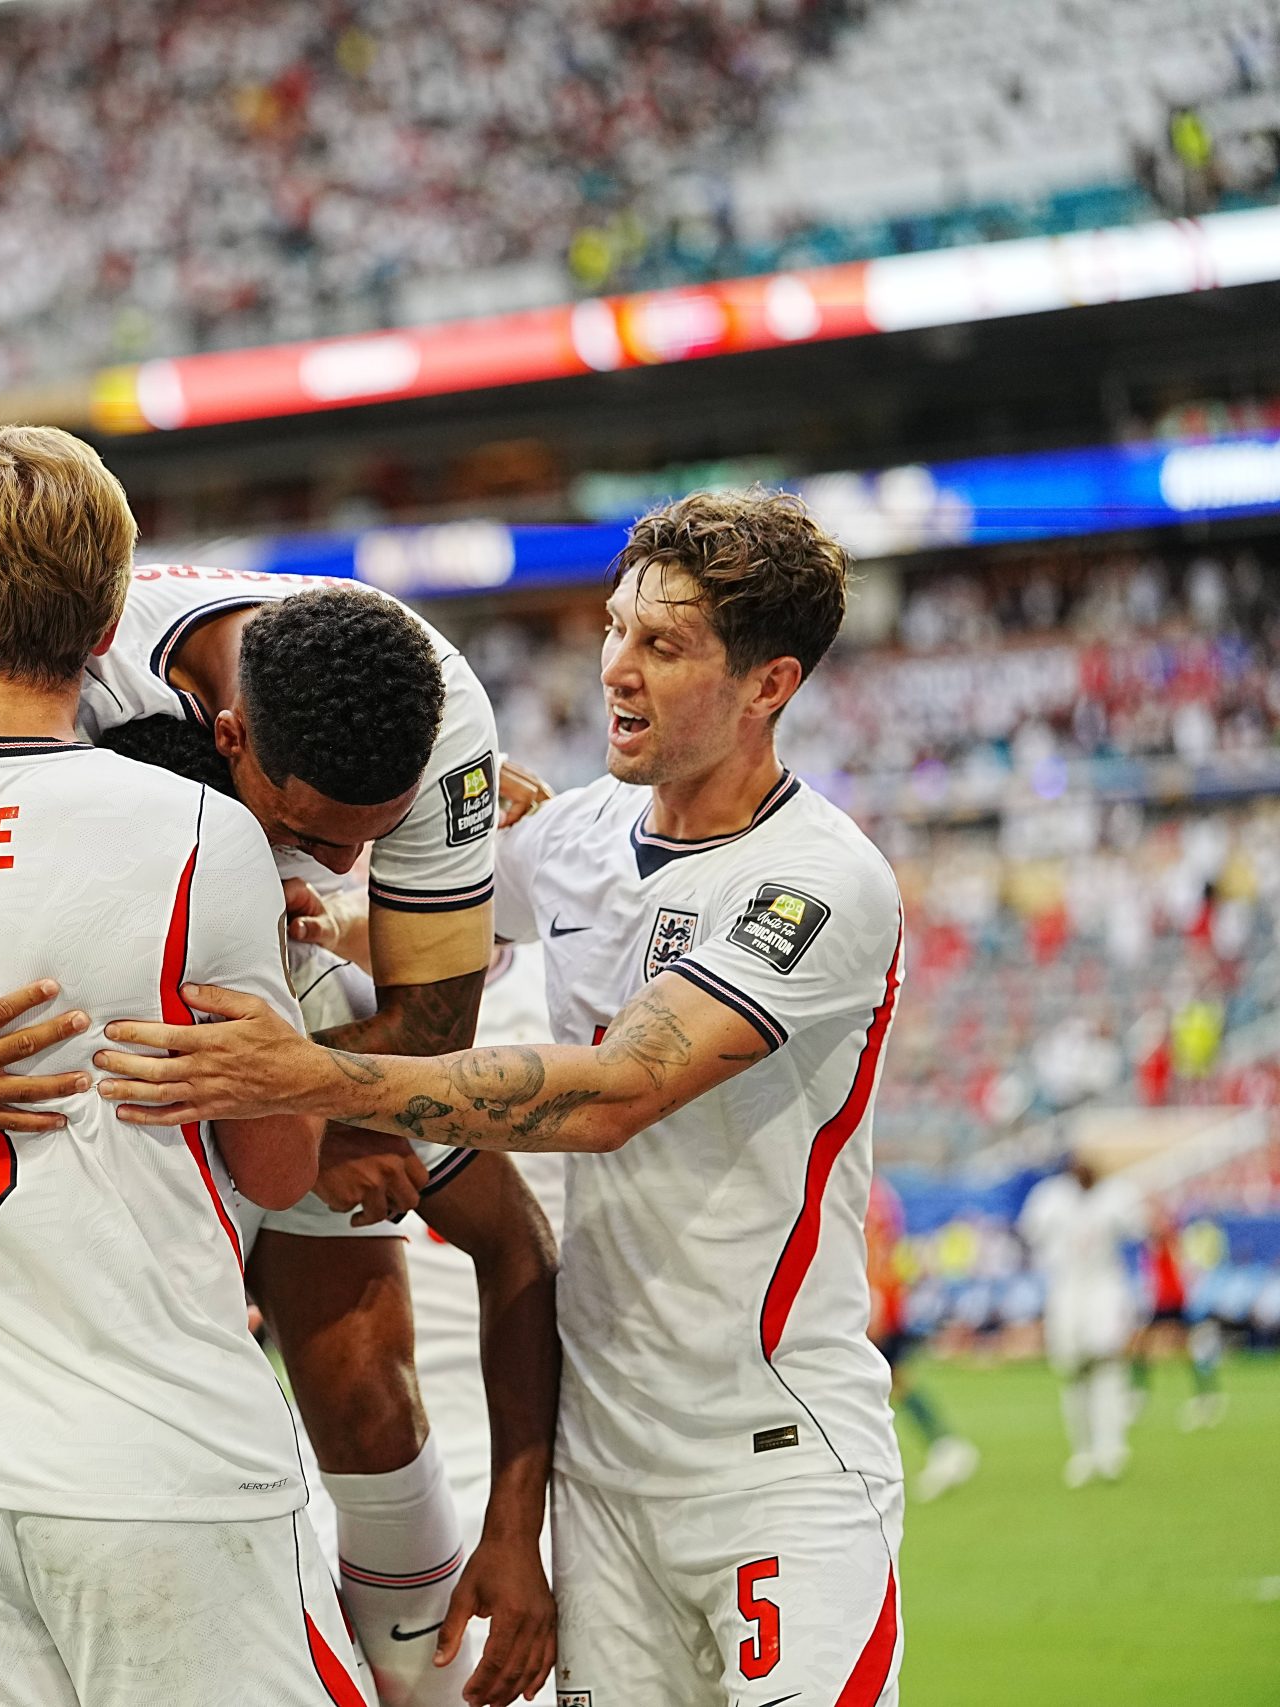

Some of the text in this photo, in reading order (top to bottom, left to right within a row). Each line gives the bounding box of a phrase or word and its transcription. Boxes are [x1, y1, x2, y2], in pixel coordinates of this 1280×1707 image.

[757, 911, 796, 937] Unite For
[743, 921, 795, 956] EDUCATION
[751, 938, 770, 954] FIFA
[238, 1478, 288, 1490] AERO-FIT
[737, 1556, 781, 1681] 5
